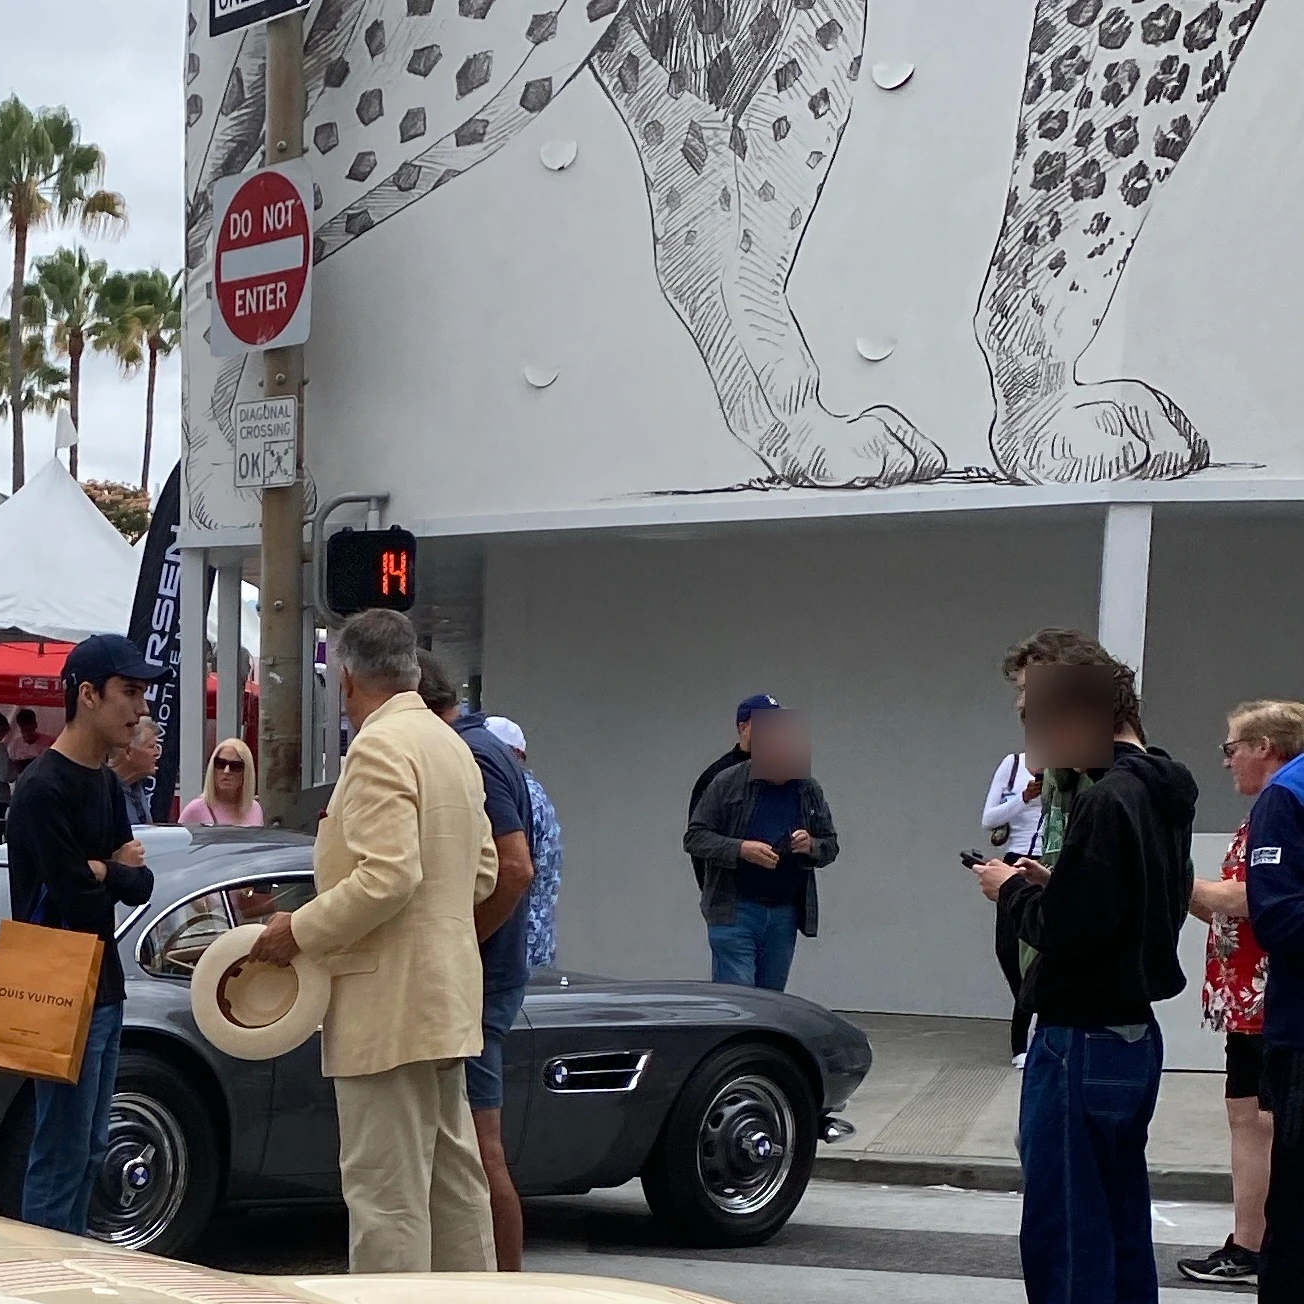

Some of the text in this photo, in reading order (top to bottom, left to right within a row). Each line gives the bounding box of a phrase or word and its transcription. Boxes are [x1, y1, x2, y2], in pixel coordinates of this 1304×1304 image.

[230, 198, 296, 240] DO NOT
[235, 281, 287, 316] ENTER
[239, 404, 291, 422] DIAGONAL
[240, 422, 291, 440] CROSSING
[239, 452, 261, 479] OK
[382, 551, 406, 595] 14
[28, 991, 74, 1008] VUITTON
